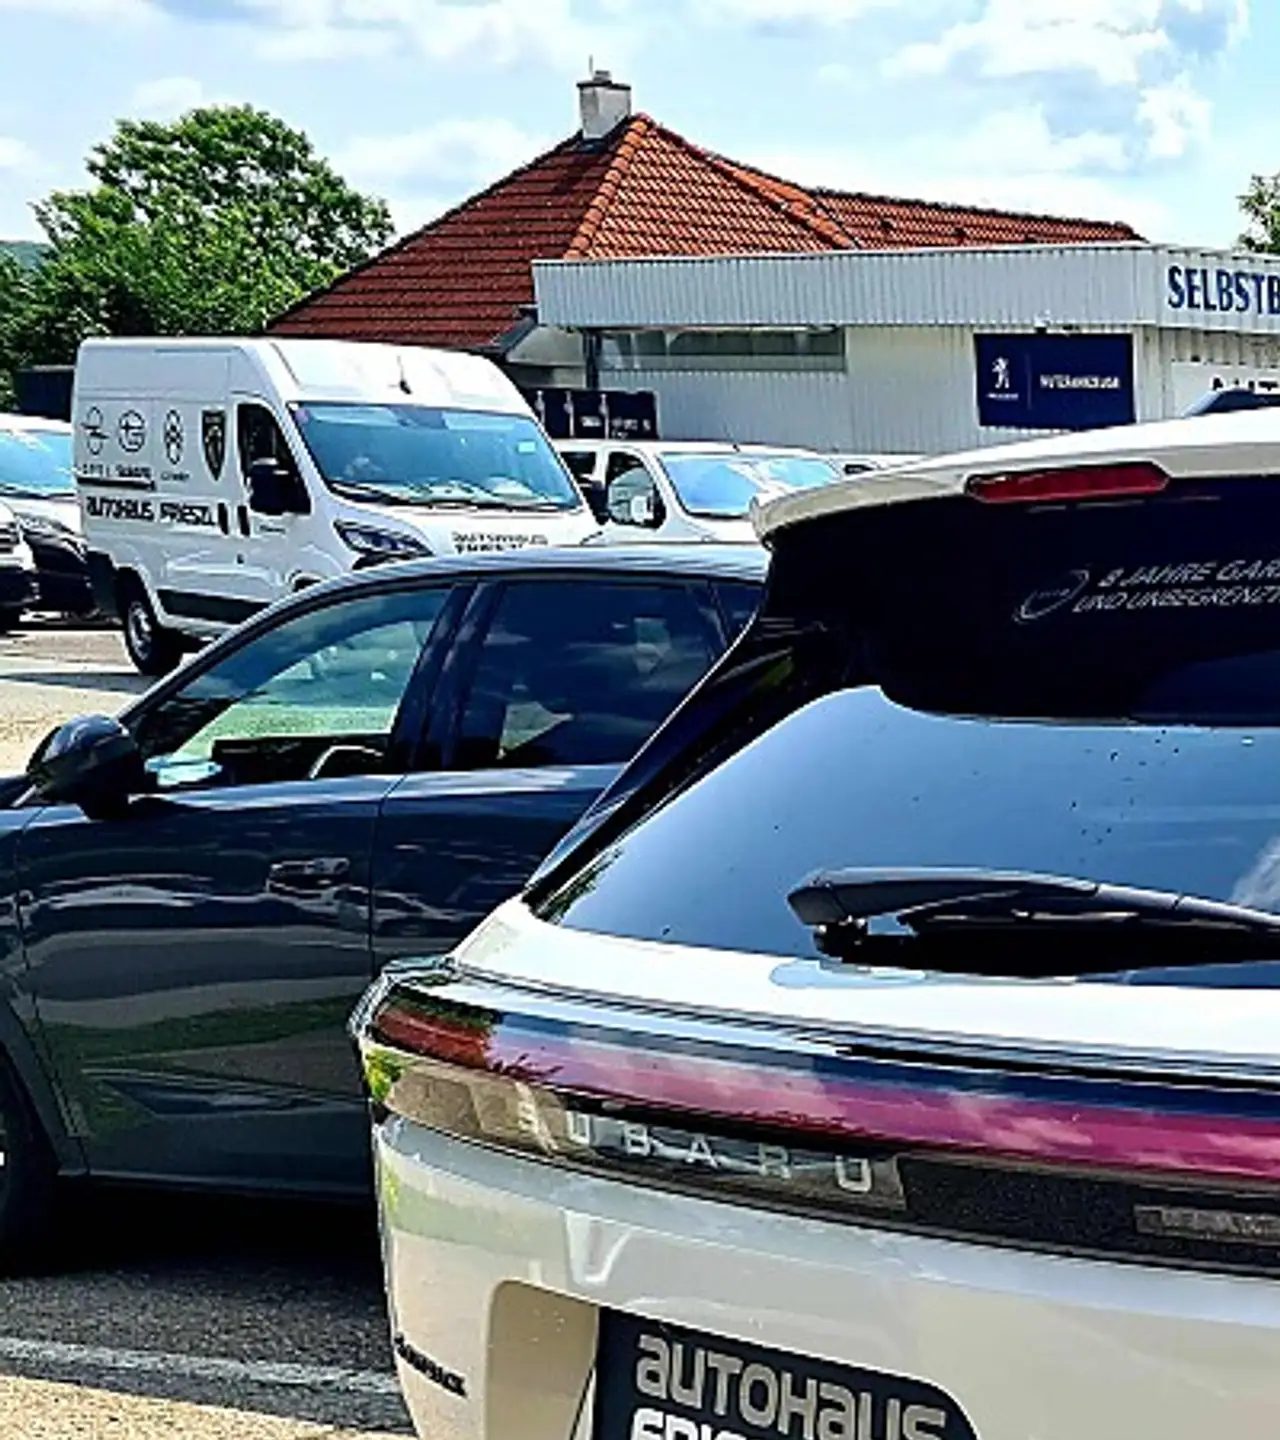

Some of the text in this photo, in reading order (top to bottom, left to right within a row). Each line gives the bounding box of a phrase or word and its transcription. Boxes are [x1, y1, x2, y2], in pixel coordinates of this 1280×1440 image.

[1098, 567, 1124, 587] 8
[1119, 562, 1217, 587] JAHRE
[1072, 591, 1128, 613] UND
[518, 1100, 873, 1193] SUBARU
